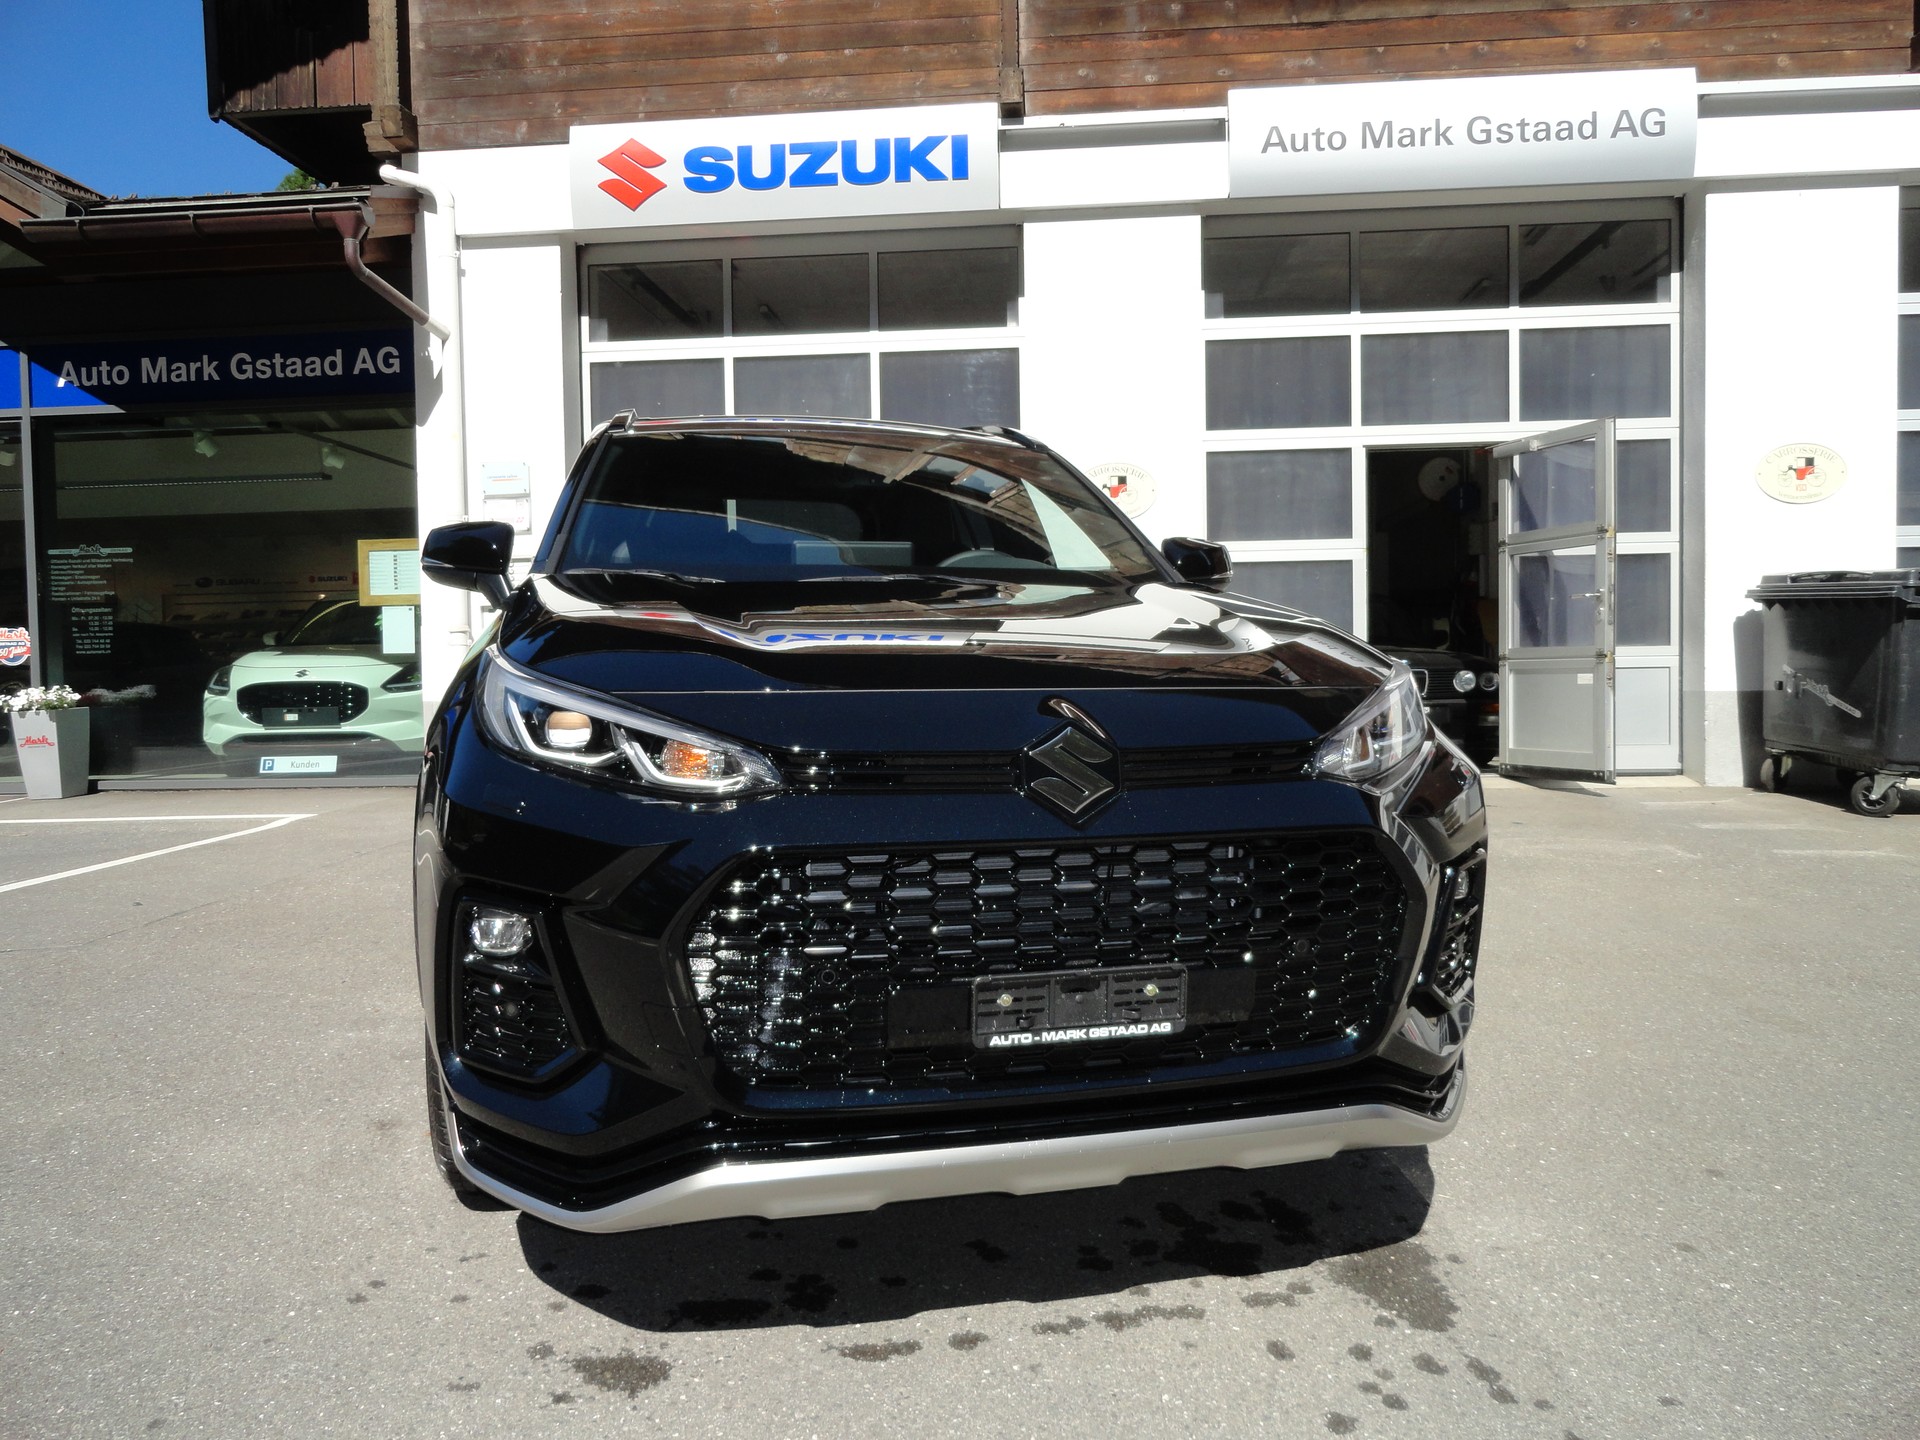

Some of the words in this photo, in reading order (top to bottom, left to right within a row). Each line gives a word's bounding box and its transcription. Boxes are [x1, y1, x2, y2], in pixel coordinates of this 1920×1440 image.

[1261, 125, 1348, 154] Auto
[1361, 118, 1454, 150] Mark
[1466, 111, 1598, 146] Gstaad
[1610, 107, 1667, 139] AG
[683, 134, 969, 194] SUZUKI
[57, 360, 130, 388] Auto
[141, 355, 220, 384] Mark
[230, 349, 343, 380] Gstaad
[352, 346, 401, 375] AG
[1766, 446, 1838, 464] CARROSSERIE
[1088, 466, 1146, 480] ARROSSERIE
[20, 735, 55, 748] Mark
[265, 760, 273, 770] P
[290, 760, 320, 768] Kunden
[989, 1033, 1032, 1046] AUTO
[1041, 1028, 1088, 1042] MARK
[1089, 1024, 1148, 1038] GSTAAD
[1150, 1022, 1172, 1033] AG
